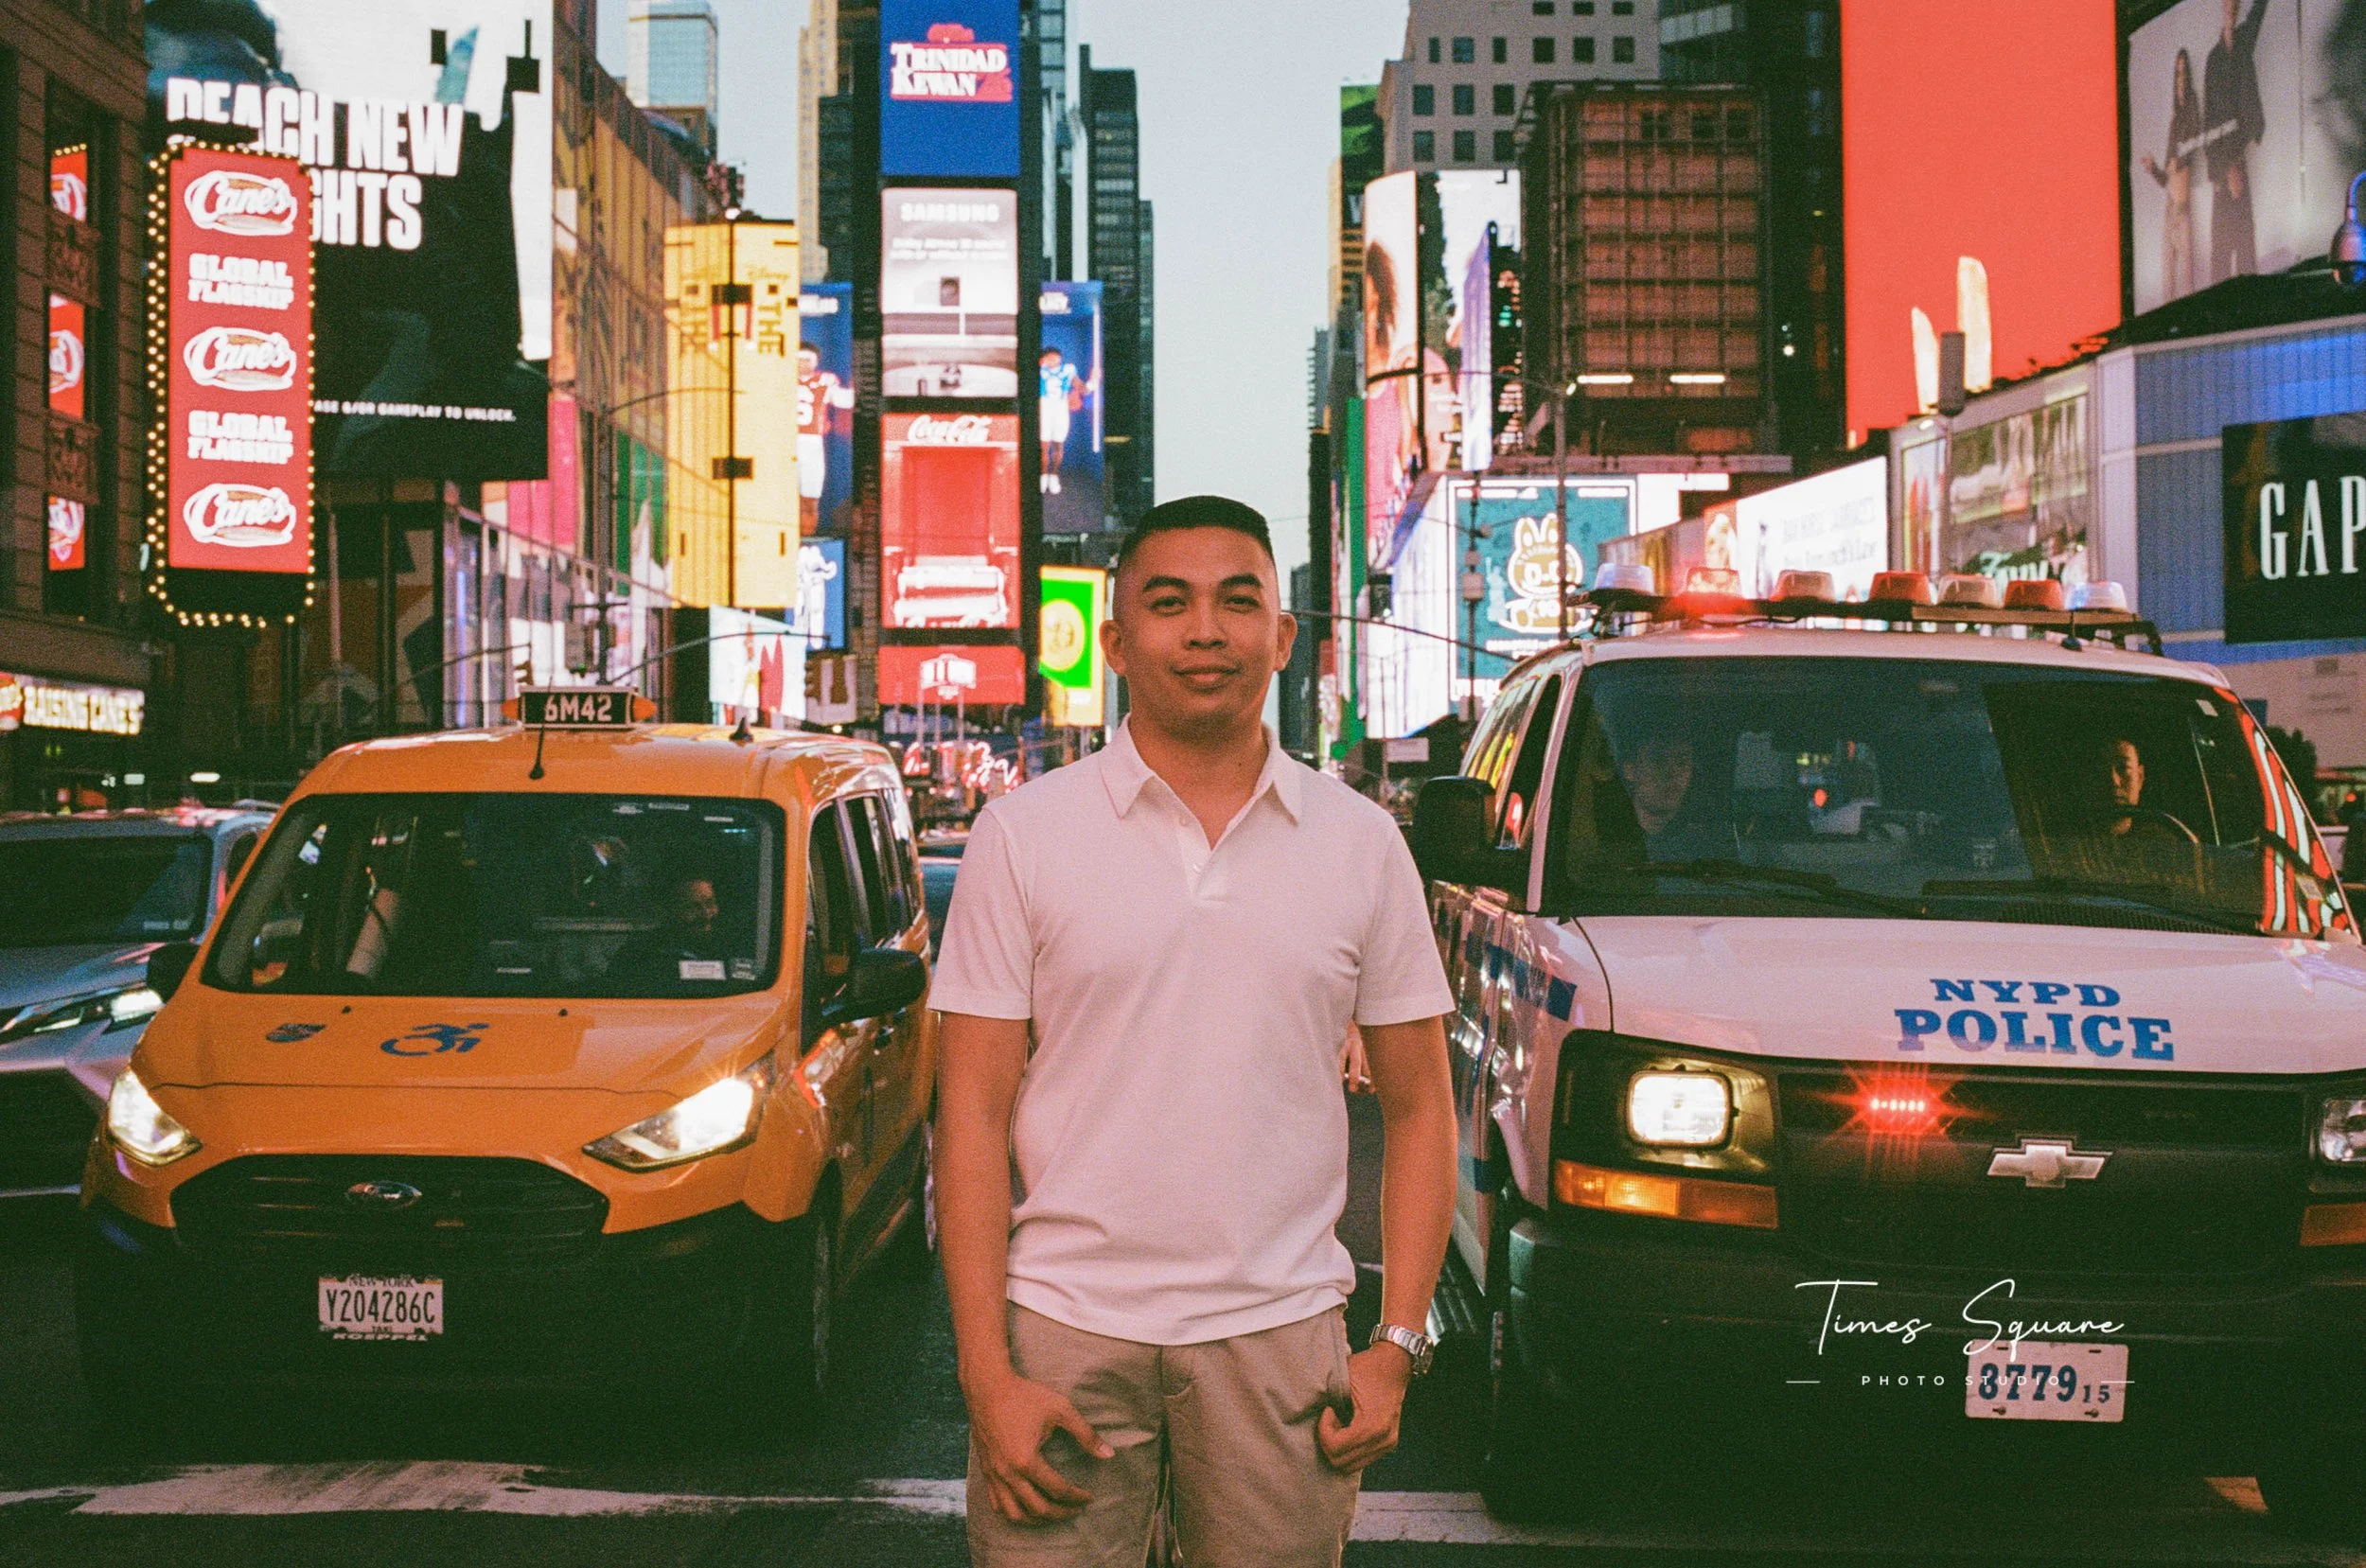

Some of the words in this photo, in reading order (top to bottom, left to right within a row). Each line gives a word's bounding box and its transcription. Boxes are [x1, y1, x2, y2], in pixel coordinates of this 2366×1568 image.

[891, 43, 1007, 72] TRINIDAD
[167, 77, 334, 167] REACH
[346, 97, 464, 177] NEW
[900, 198, 1000, 222] SAMSUNG
[188, 253, 293, 288] GLOBAL
[187, 279, 294, 309] FLAGSHIP
[757, 300, 784, 355] THE
[377, 402, 442, 418] GAMEPLAY
[445, 406, 463, 419] TO
[188, 410, 293, 443] GLOBAL
[187, 436, 293, 465] FLAGSHIP
[2259, 475, 2366, 580] GAP
[544, 695, 612, 722] 6M42
[1930, 978, 2121, 1008] NYPD
[1894, 1009, 2175, 1061] POLICE
[348, 1275, 376, 1287] NEW
[381, 1276, 415, 1288] YORK
[326, 1288, 435, 1324] Y204286C
[1978, 1363, 2077, 1402] 8779
[2083, 1384, 2111, 1403] 15
